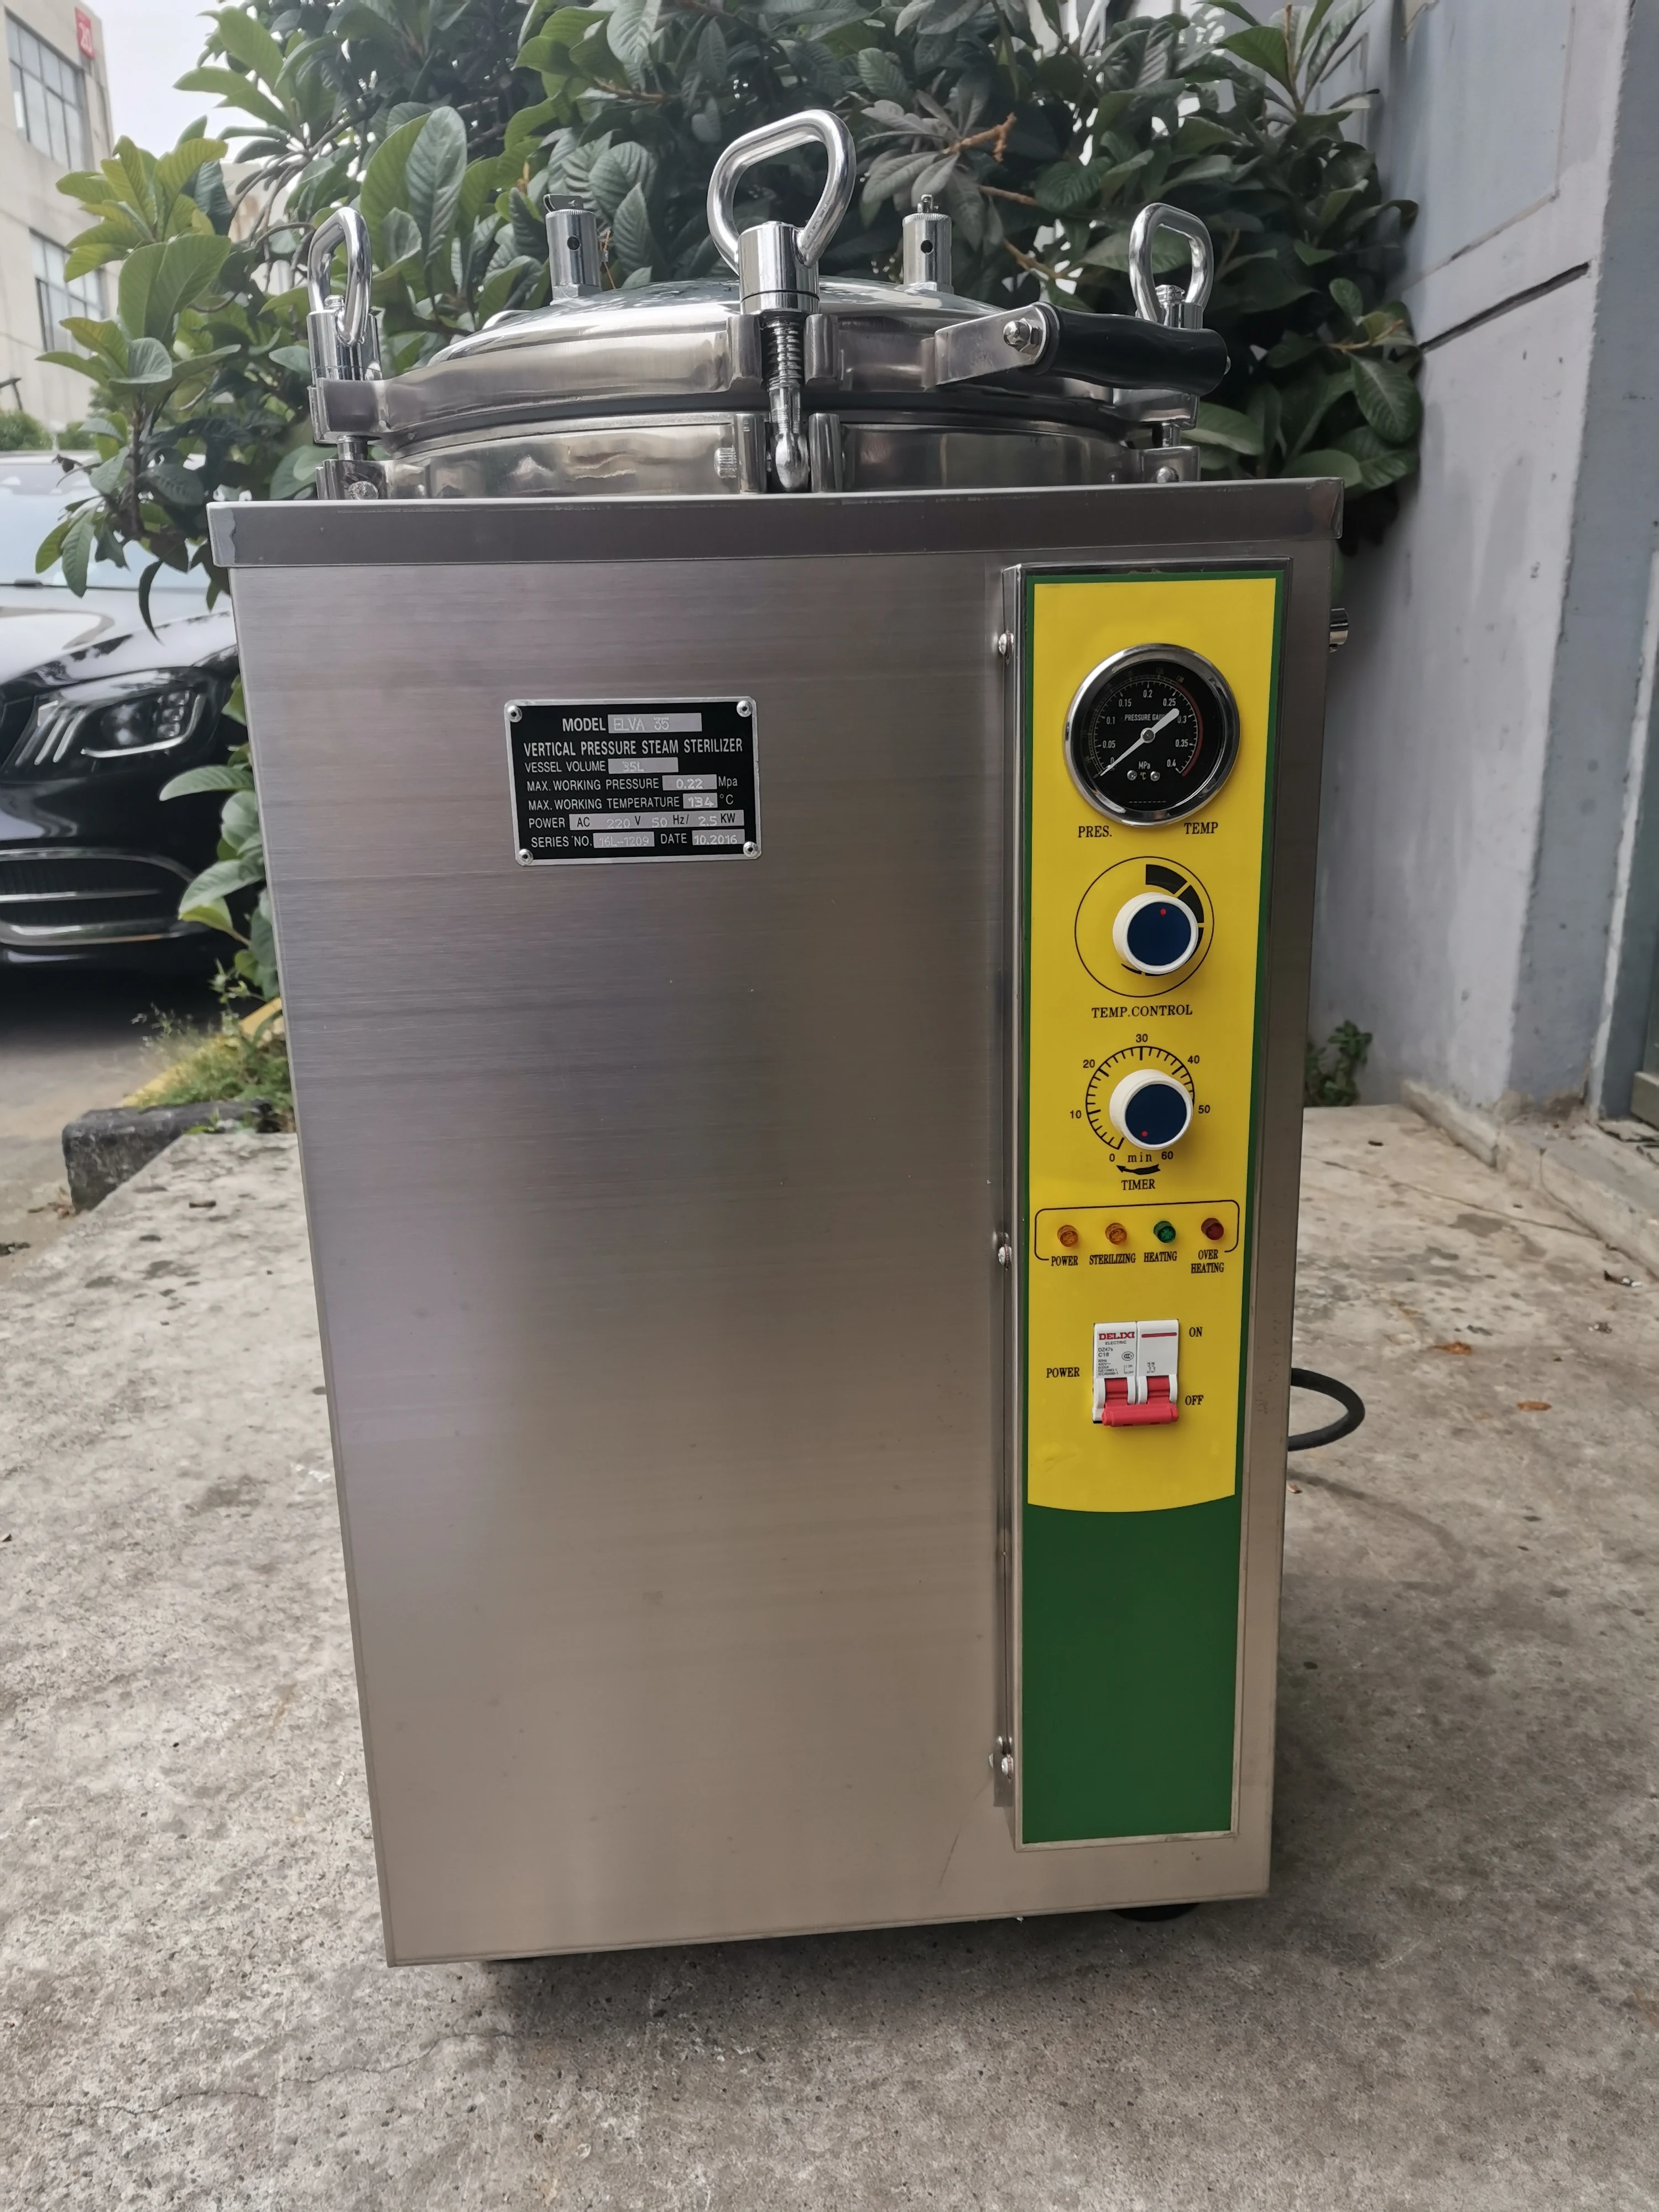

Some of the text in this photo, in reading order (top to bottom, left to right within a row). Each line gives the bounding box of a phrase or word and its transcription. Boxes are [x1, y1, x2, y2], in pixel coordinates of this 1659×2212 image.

[1143, 690, 1152, 698] 0.2
[1119, 698, 1131, 707] 0.15
[1163, 698, 1176, 706] 0.25
[563, 718, 606, 732] MODEL
[654, 717, 669, 731] 35
[1107, 716, 1115, 724] 0.1
[1177, 715, 1187, 723] 0.3
[524, 738, 743, 757] VERTICAL PRESSURE STEAM STERILIZER
[525, 761, 644, 773] VESSEL VOLUME 35L
[527, 776, 738, 791] MAX. WORKING PRESSURE 0.22 Mpa
[529, 799, 552, 810] MAX.
[556, 797, 602, 810] WORKING
[608, 796, 680, 808] TEMPERATURE
[687, 796, 714, 807] 134
[529, 817, 565, 828] POWER
[577, 816, 590, 827] AC
[606, 818, 630, 828] 220
[635, 816, 641, 826] V
[651, 817, 668, 827] 50
[721, 813, 735, 823] KW
[1078, 825, 1112, 837] PRES.
[1184, 822, 1218, 834] TEMP
[531, 836, 569, 848] SERIES
[574, 835, 592, 847] NO.
[661, 833, 687, 844] DATE
[1092, 1005, 1192, 1018] TEMP.CONTROL
[1136, 1034, 1148, 1042] 30
[1083, 1060, 1095, 1068] 20
[1188, 1055, 1199, 1063] 40
[1070, 1110, 1081, 1119] 10
[1109, 1151, 1173, 1162] 0 min 60
[1121, 1179, 1155, 1190] TIMER
[1089, 1253, 1136, 1265] STERILIZING
[1144, 1251, 1177, 1262] HEATING
[1198, 1249, 1218, 1260] OVER
[1051, 1256, 1078, 1266] POWER
[1191, 1262, 1224, 1274] HEATING
[1099, 1332, 1135, 1340] DELIXI
[1189, 1327, 1202, 1337] ON
[1046, 1367, 1079, 1378] POWER
[1185, 1395, 1203, 1405] OFF
